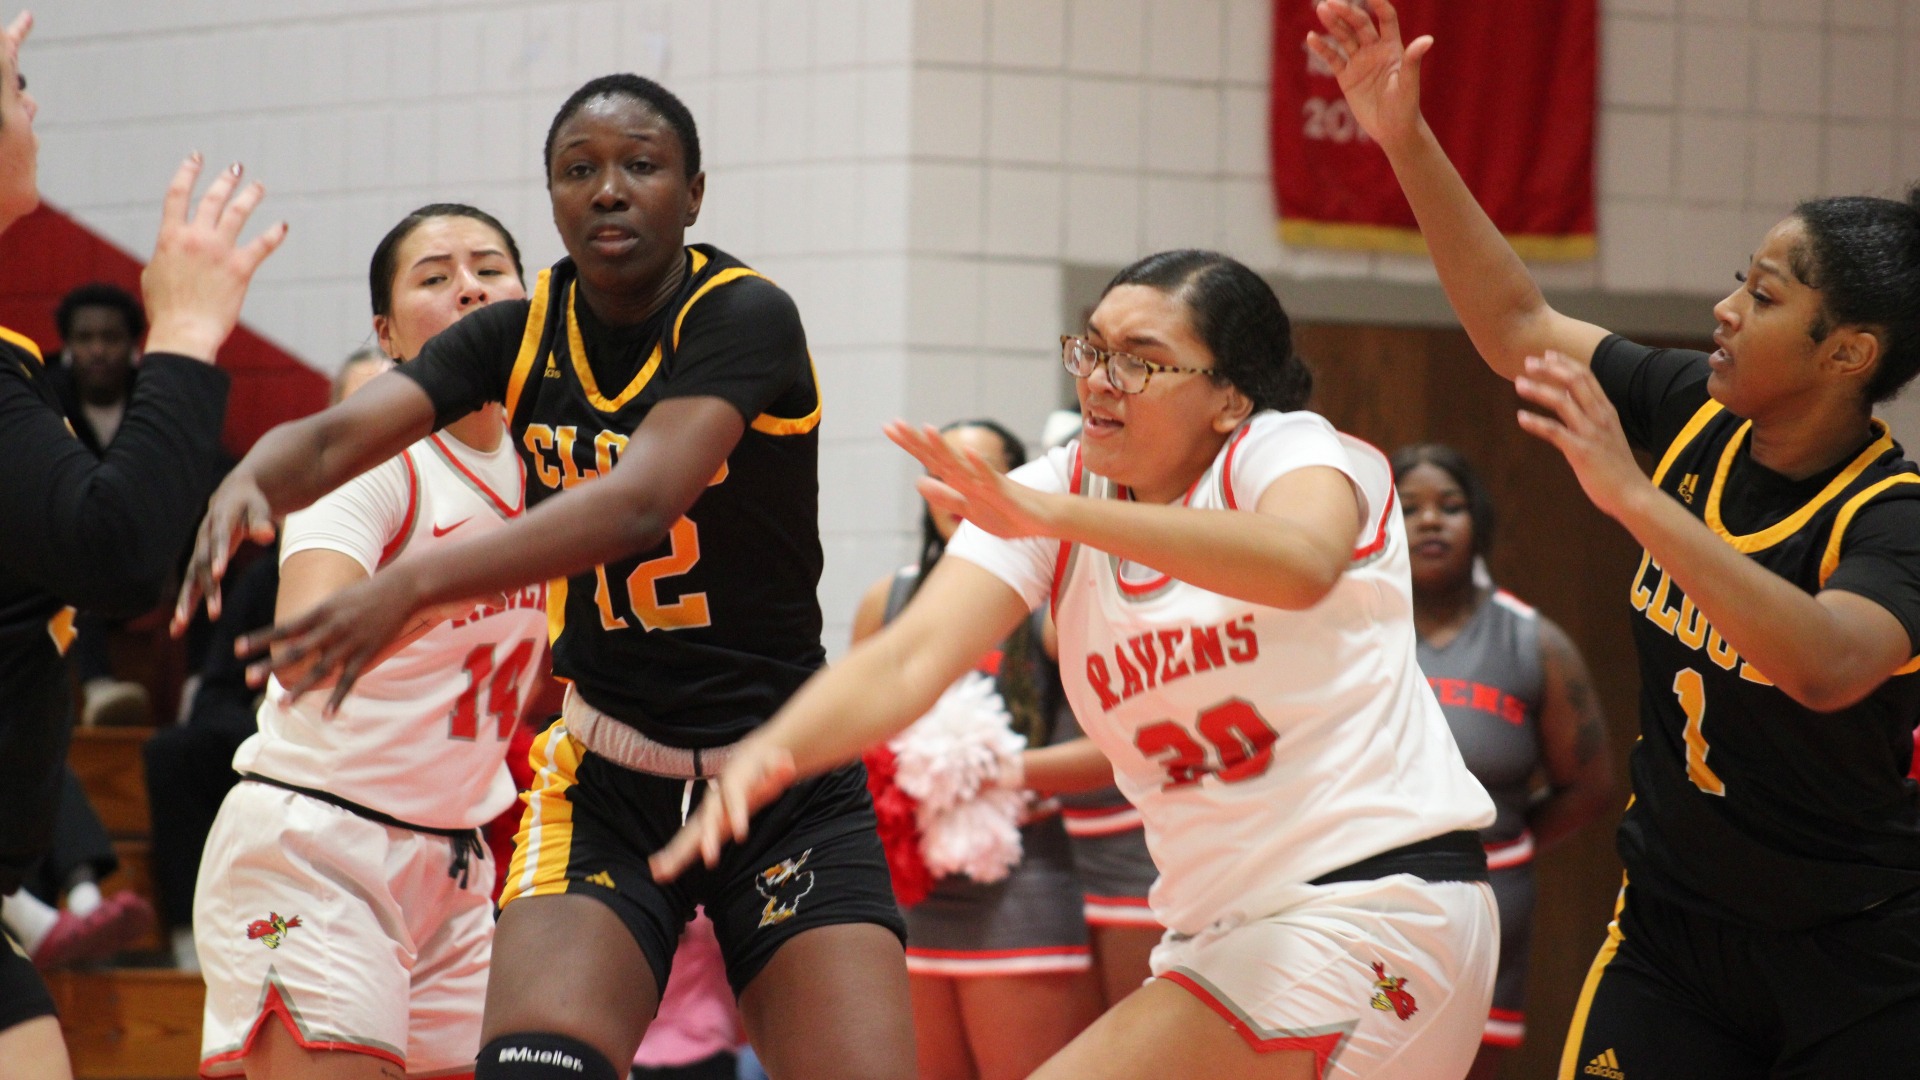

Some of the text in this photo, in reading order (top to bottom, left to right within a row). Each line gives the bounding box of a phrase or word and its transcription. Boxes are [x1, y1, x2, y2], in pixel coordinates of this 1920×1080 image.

[523, 423, 729, 490] CLO
[594, 514, 711, 632] 12
[1630, 548, 1775, 686] CLOU
[448, 637, 536, 742] 14
[1086, 613, 1259, 712] RAVENS
[1672, 666, 1726, 797] 1
[511, 1046, 583, 1071] Mueller
[1584, 1065, 1624, 1080] adidas
